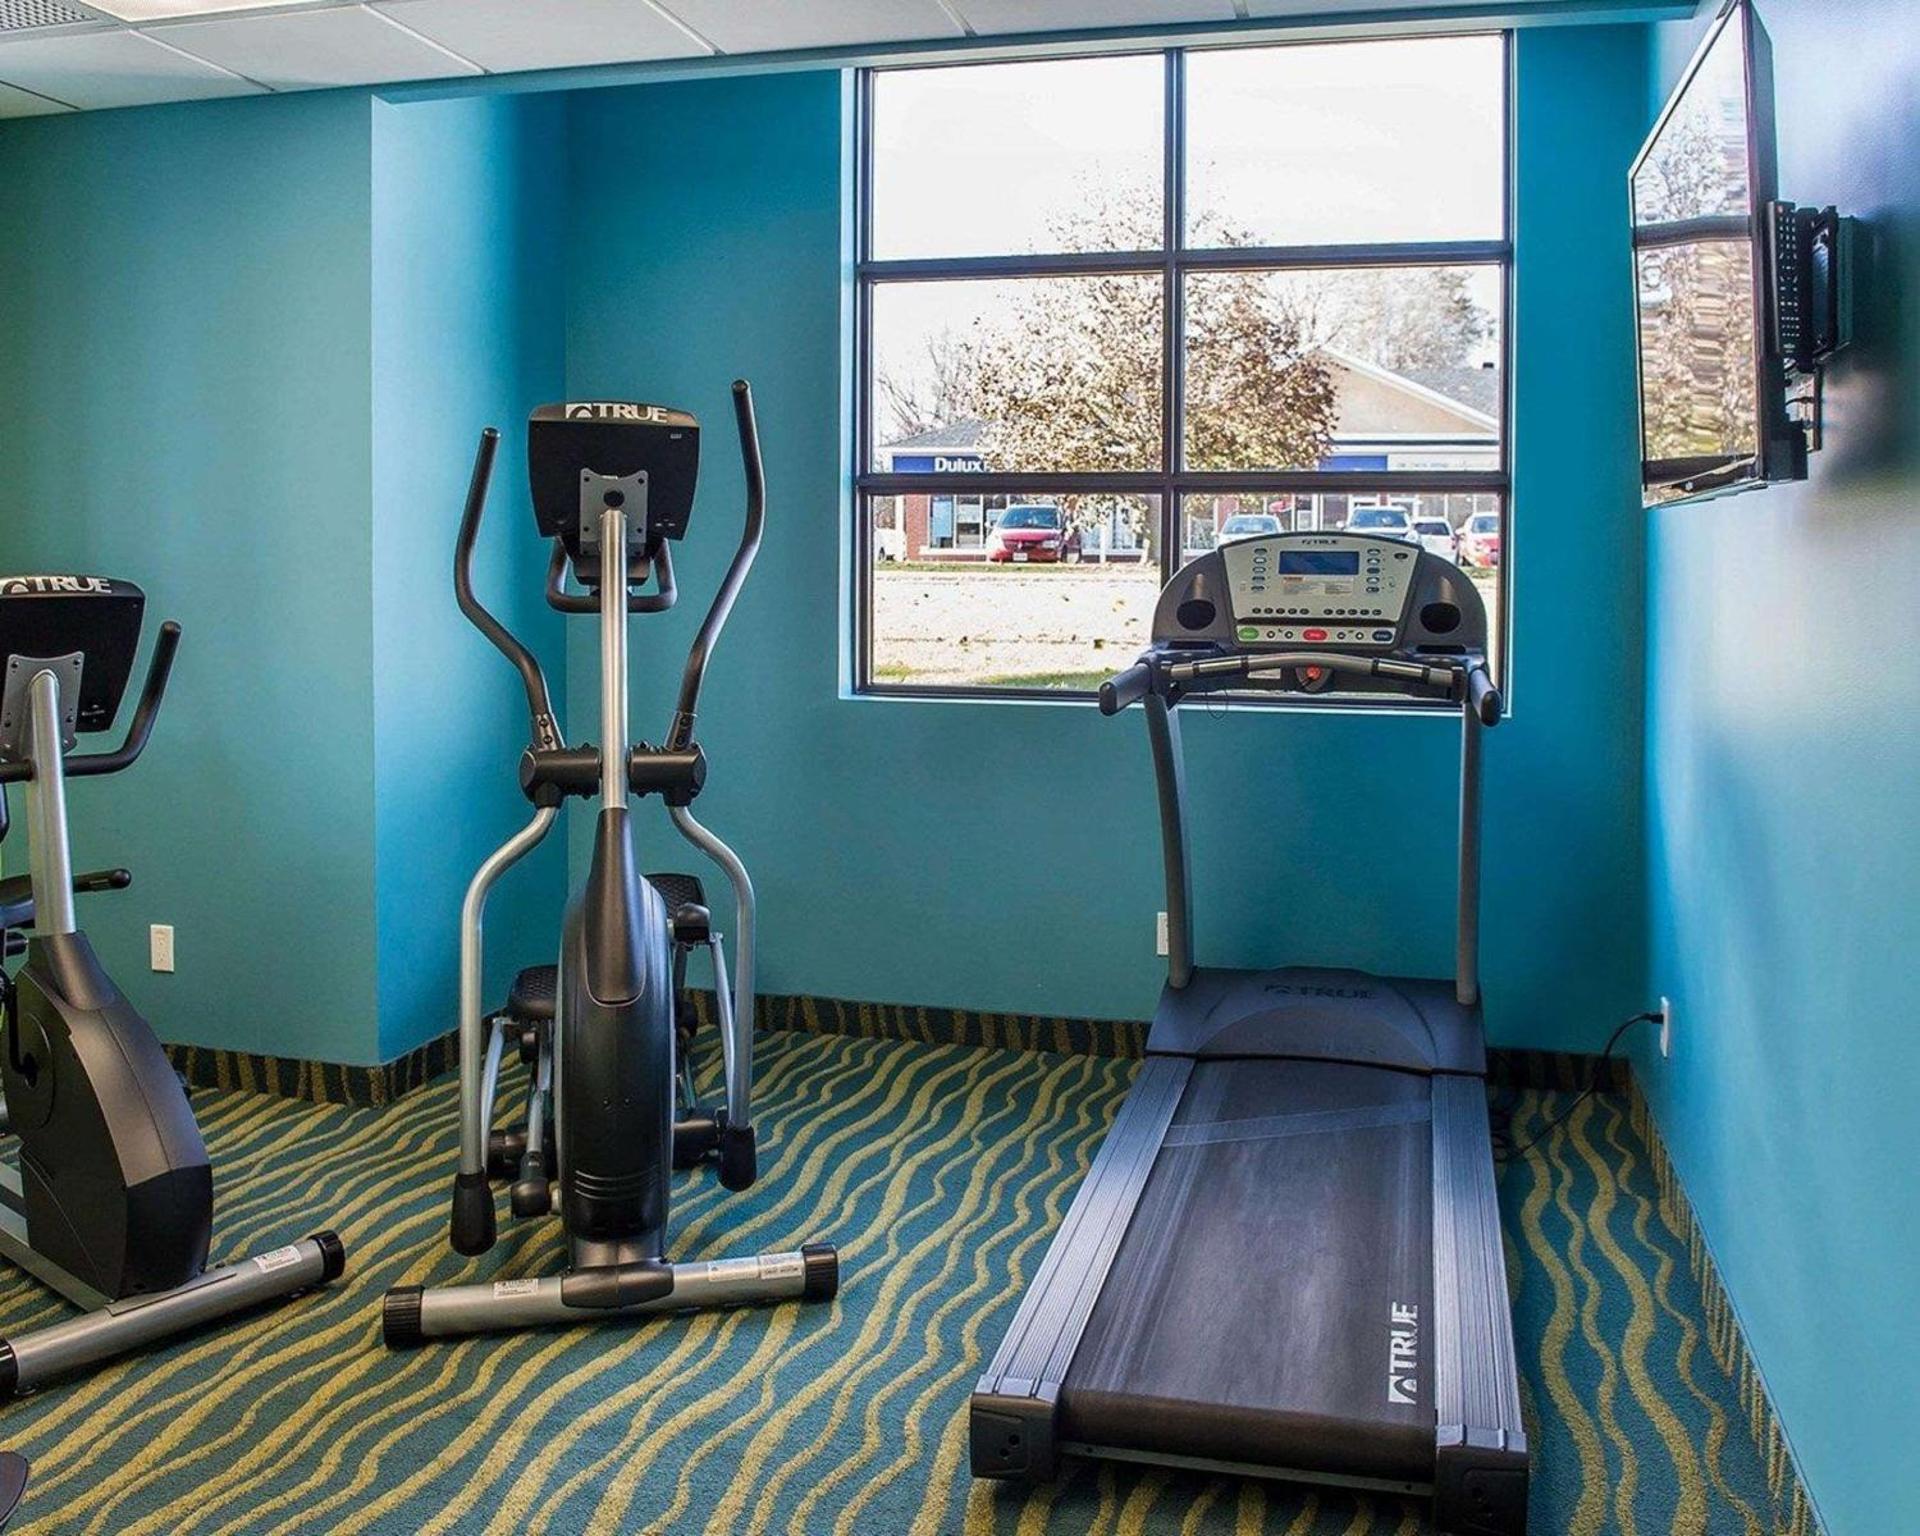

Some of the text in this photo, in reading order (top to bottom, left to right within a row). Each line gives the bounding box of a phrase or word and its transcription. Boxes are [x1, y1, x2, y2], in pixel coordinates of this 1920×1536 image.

[593, 402, 668, 424] TRUE
[934, 457, 981, 472] Dulux
[26, 576, 112, 594] TRUE
[1389, 1301, 1418, 1374] TRUE
